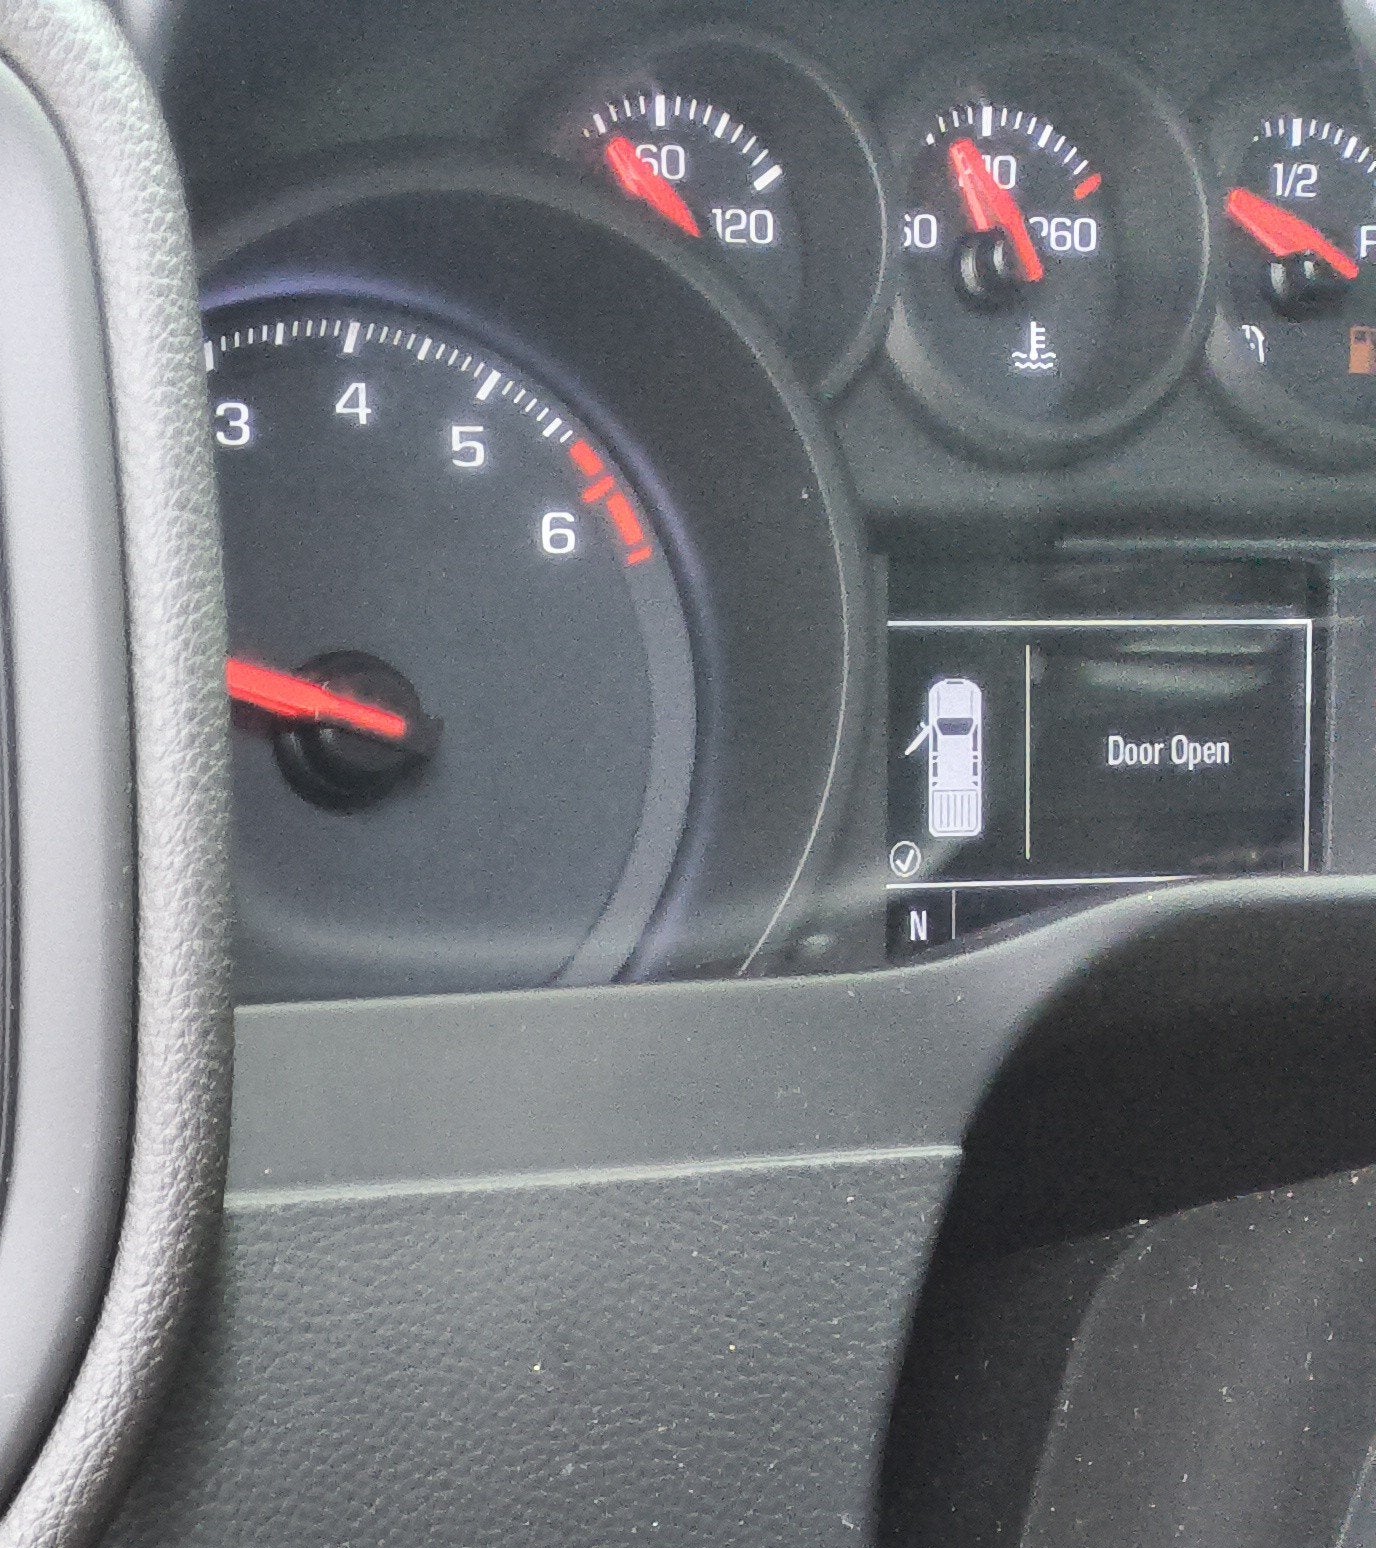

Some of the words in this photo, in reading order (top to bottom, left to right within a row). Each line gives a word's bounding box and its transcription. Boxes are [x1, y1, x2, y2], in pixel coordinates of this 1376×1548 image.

[1273, 162, 1319, 198] 1/2
[711, 208, 775, 245] 120
[334, 381, 373, 426] 4
[214, 401, 251, 447] 3
[450, 425, 487, 468] 5
[540, 511, 577, 555] 6
[1106, 734, 1165, 766] Door
[1170, 733, 1231, 771] Open
[909, 909, 928, 942] N
